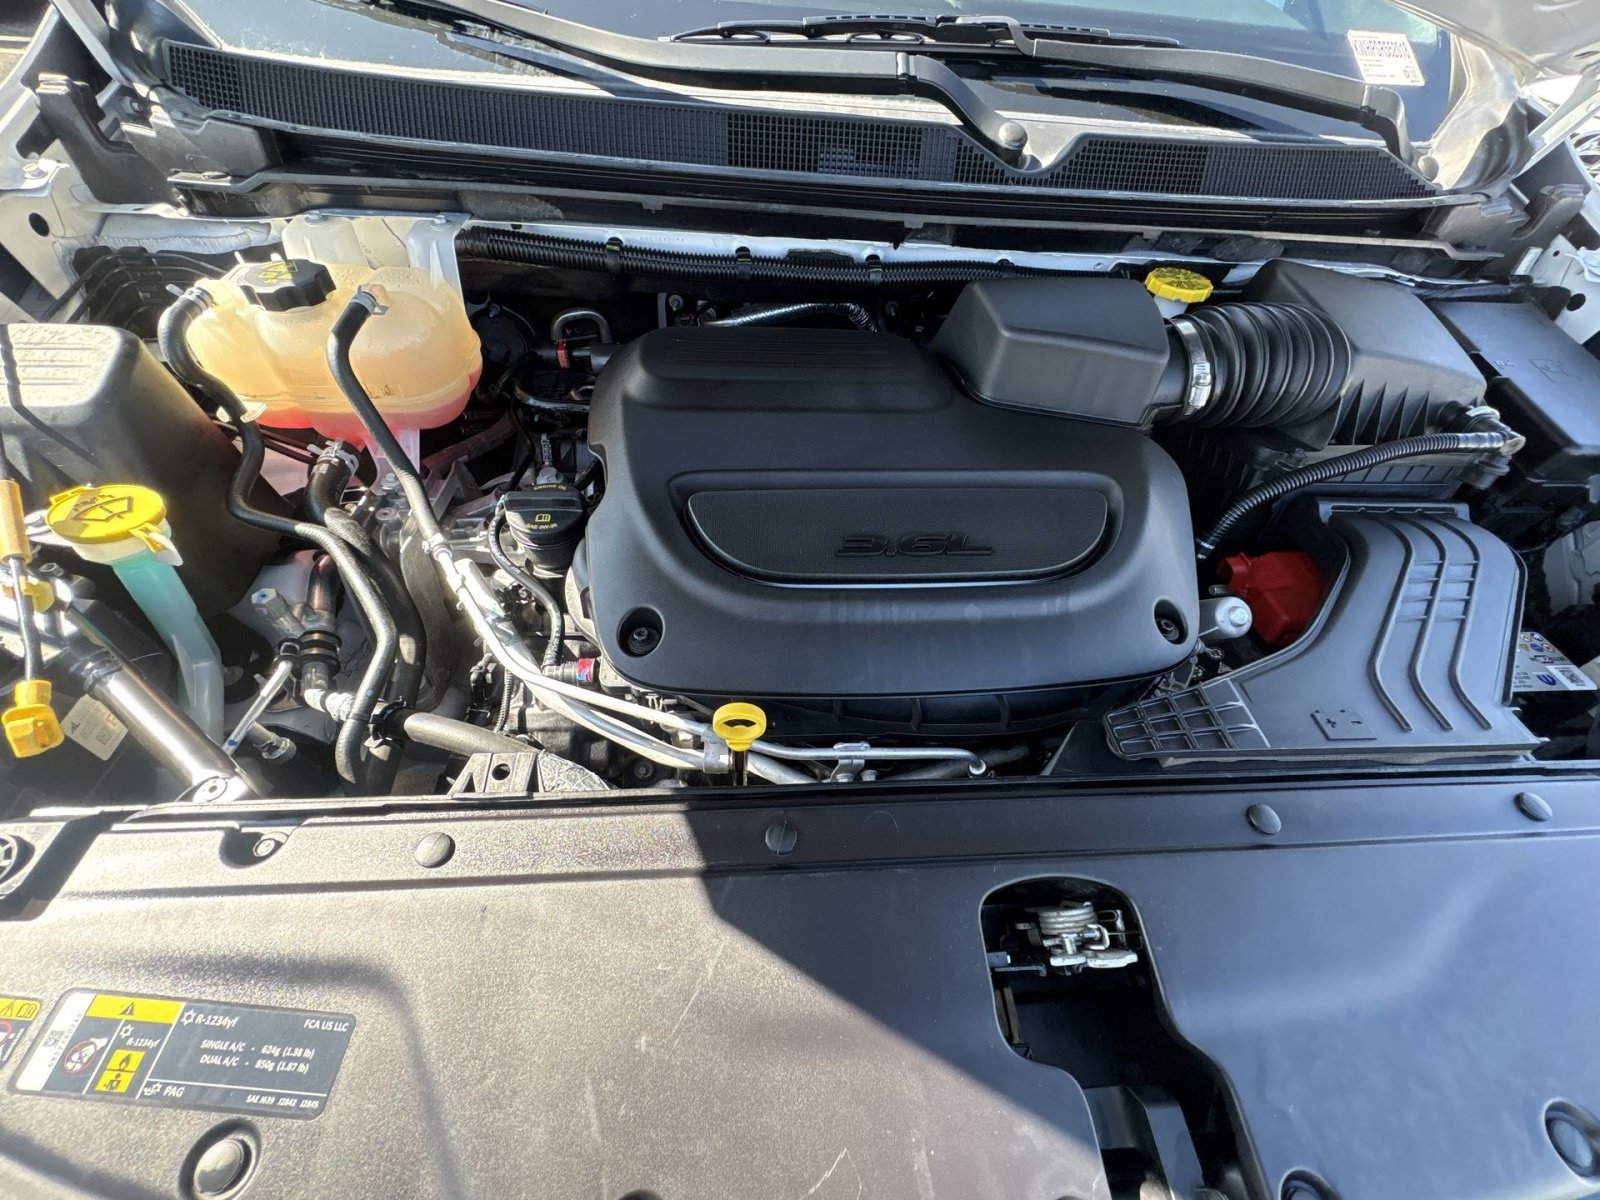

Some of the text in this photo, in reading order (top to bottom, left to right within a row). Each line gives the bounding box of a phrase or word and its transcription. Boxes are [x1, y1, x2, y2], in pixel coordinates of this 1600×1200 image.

[835, 534, 992, 557] 3.6L
[195, 1014, 239, 1029] R-1234yf
[304, 1018, 349, 1032] FCA US LLC
[200, 1039, 229, 1051] SINGLE
[229, 1040, 246, 1052] A/C
[261, 1044, 281, 1057] 624g
[303, 1048, 315, 1060] lb)
[199, 1054, 221, 1065] DUAL
[222, 1055, 239, 1067] A/C
[276, 1060, 297, 1072] (1.87
[297, 1062, 309, 1075] lb)
[162, 1085, 185, 1098] PAG
[246, 1094, 259, 1104] SAE
